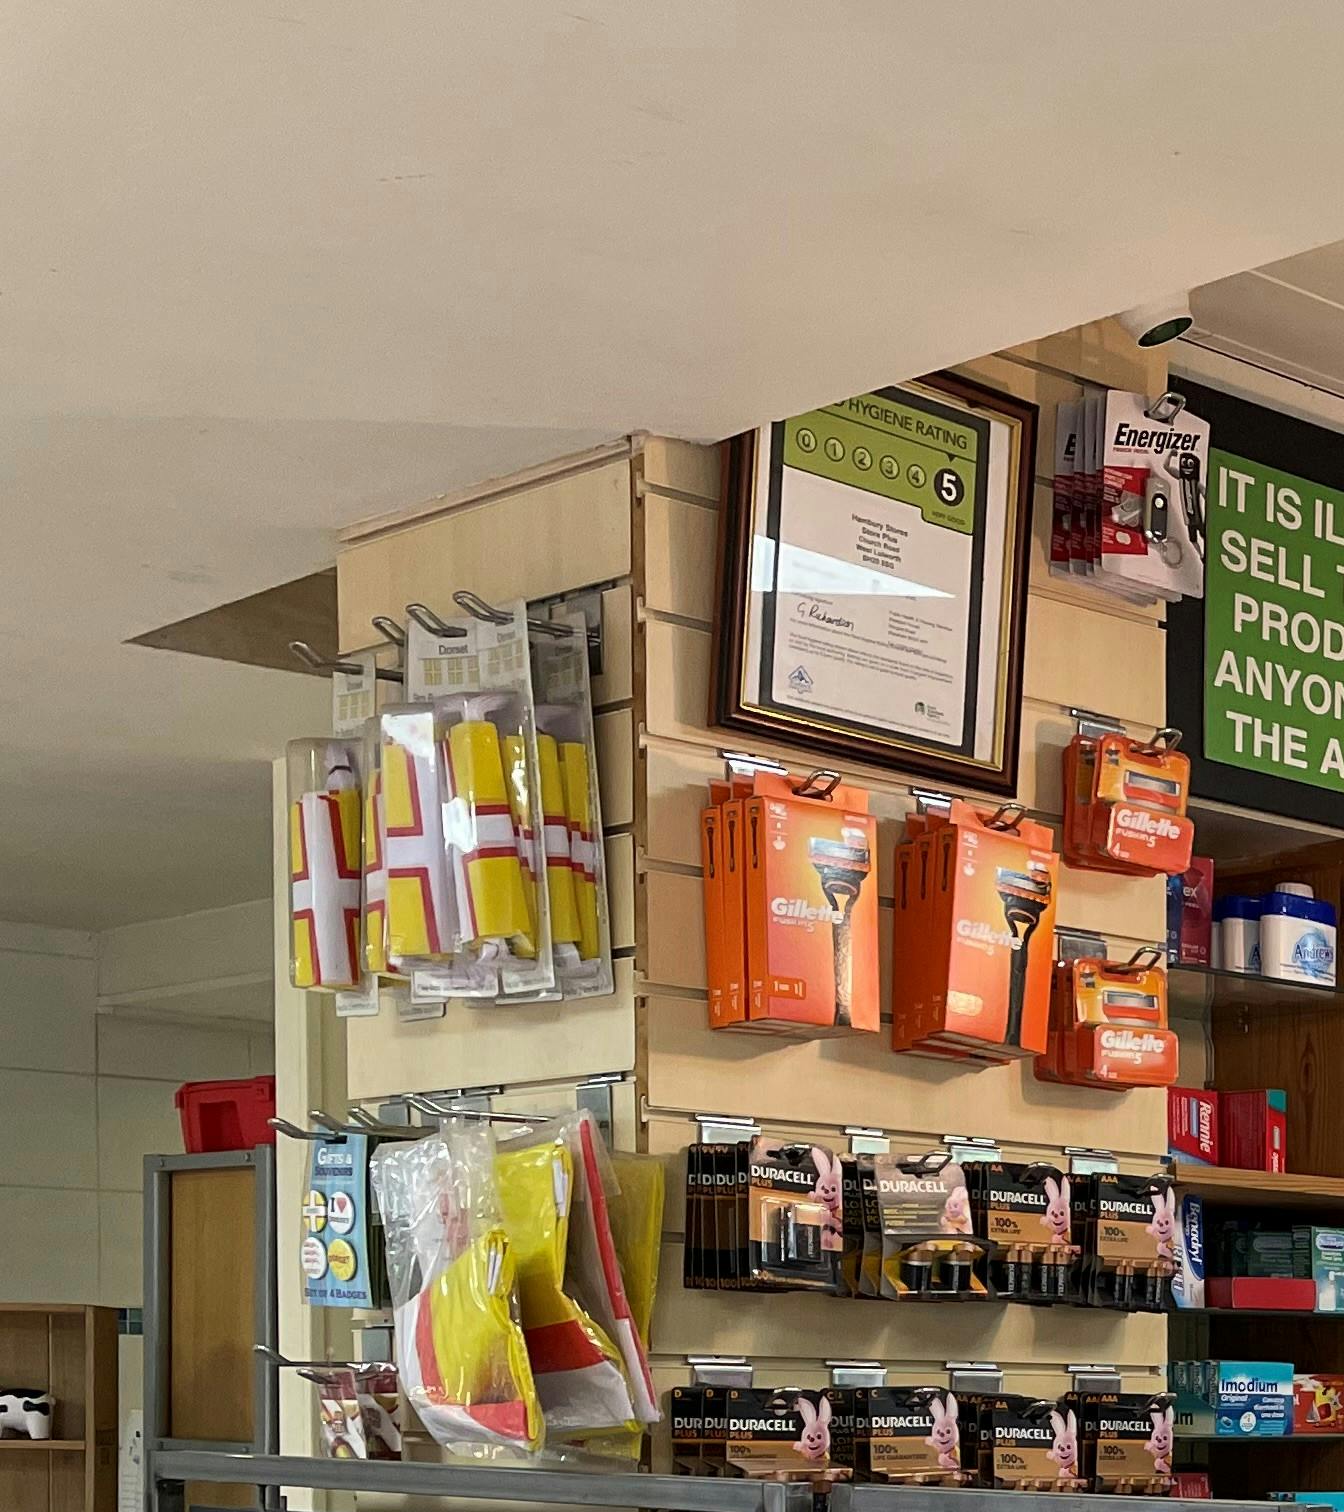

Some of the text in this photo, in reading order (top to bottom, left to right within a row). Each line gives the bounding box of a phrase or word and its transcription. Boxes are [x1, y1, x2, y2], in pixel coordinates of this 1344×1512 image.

[848, 398, 968, 450] HYGIENE RATING
[1113, 422, 1201, 456] Energizer
[1218, 466, 1256, 513] IT
[1265, 482, 1302, 532] IS
[1220, 529, 1326, 599] SELL
[1225, 710, 1308, 770] THE
[1115, 808, 1181, 840] Gillette
[770, 897, 845, 925] Gillette
[1100, 1029, 1165, 1054] Gillette
[1199, 1100, 1212, 1153] Rennie
[751, 1165, 815, 1186] DURACELL
[880, 1179, 948, 1194] DURACELL
[990, 1190, 1047, 1206] DURACELL
[1189, 1202, 1204, 1263] Benadryl
[1221, 1378, 1278, 1393] Imodium
[729, 1418, 796, 1432] DURACELL
[871, 1415, 933, 1428] DURACELL
[995, 1427, 1053, 1441] DURACELL
